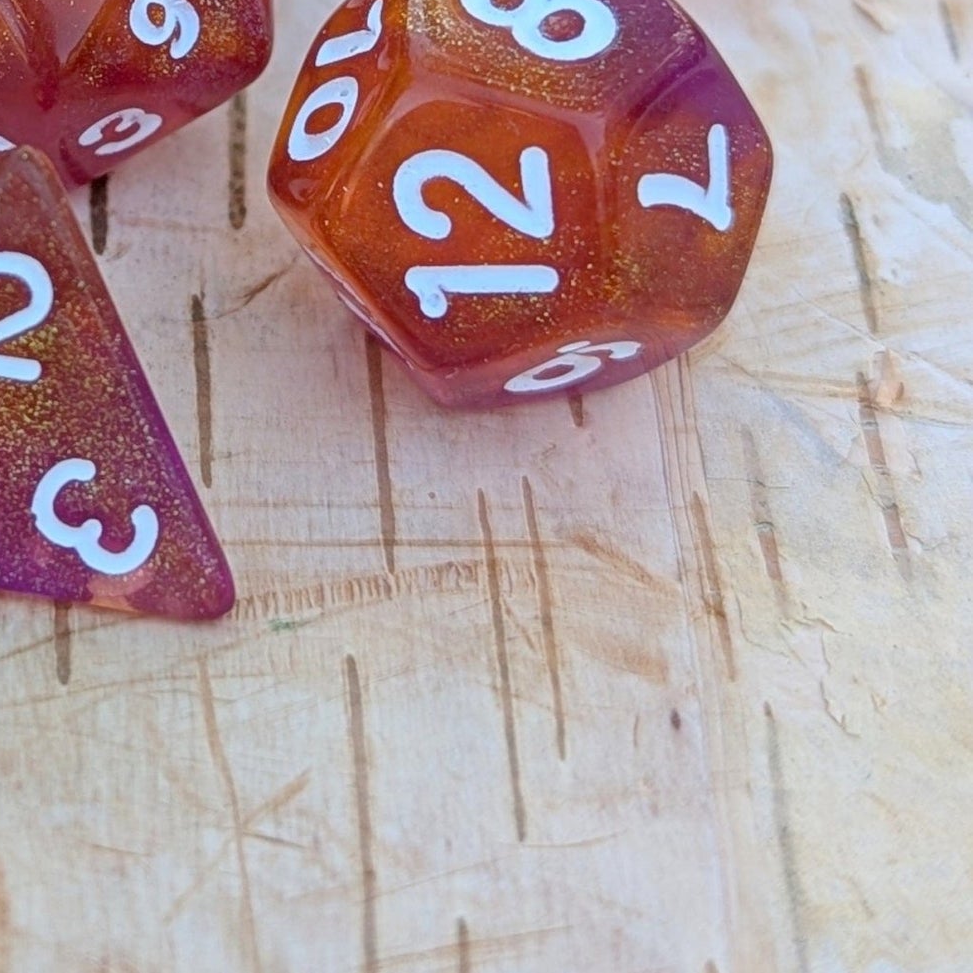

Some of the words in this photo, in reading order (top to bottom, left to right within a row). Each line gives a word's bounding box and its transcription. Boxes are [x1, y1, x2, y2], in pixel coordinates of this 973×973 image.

[79, 108, 162, 155] 3
[637, 124, 734, 231] 7
[393, 147, 559, 318] 12
[31, 458, 158, 576] 3
